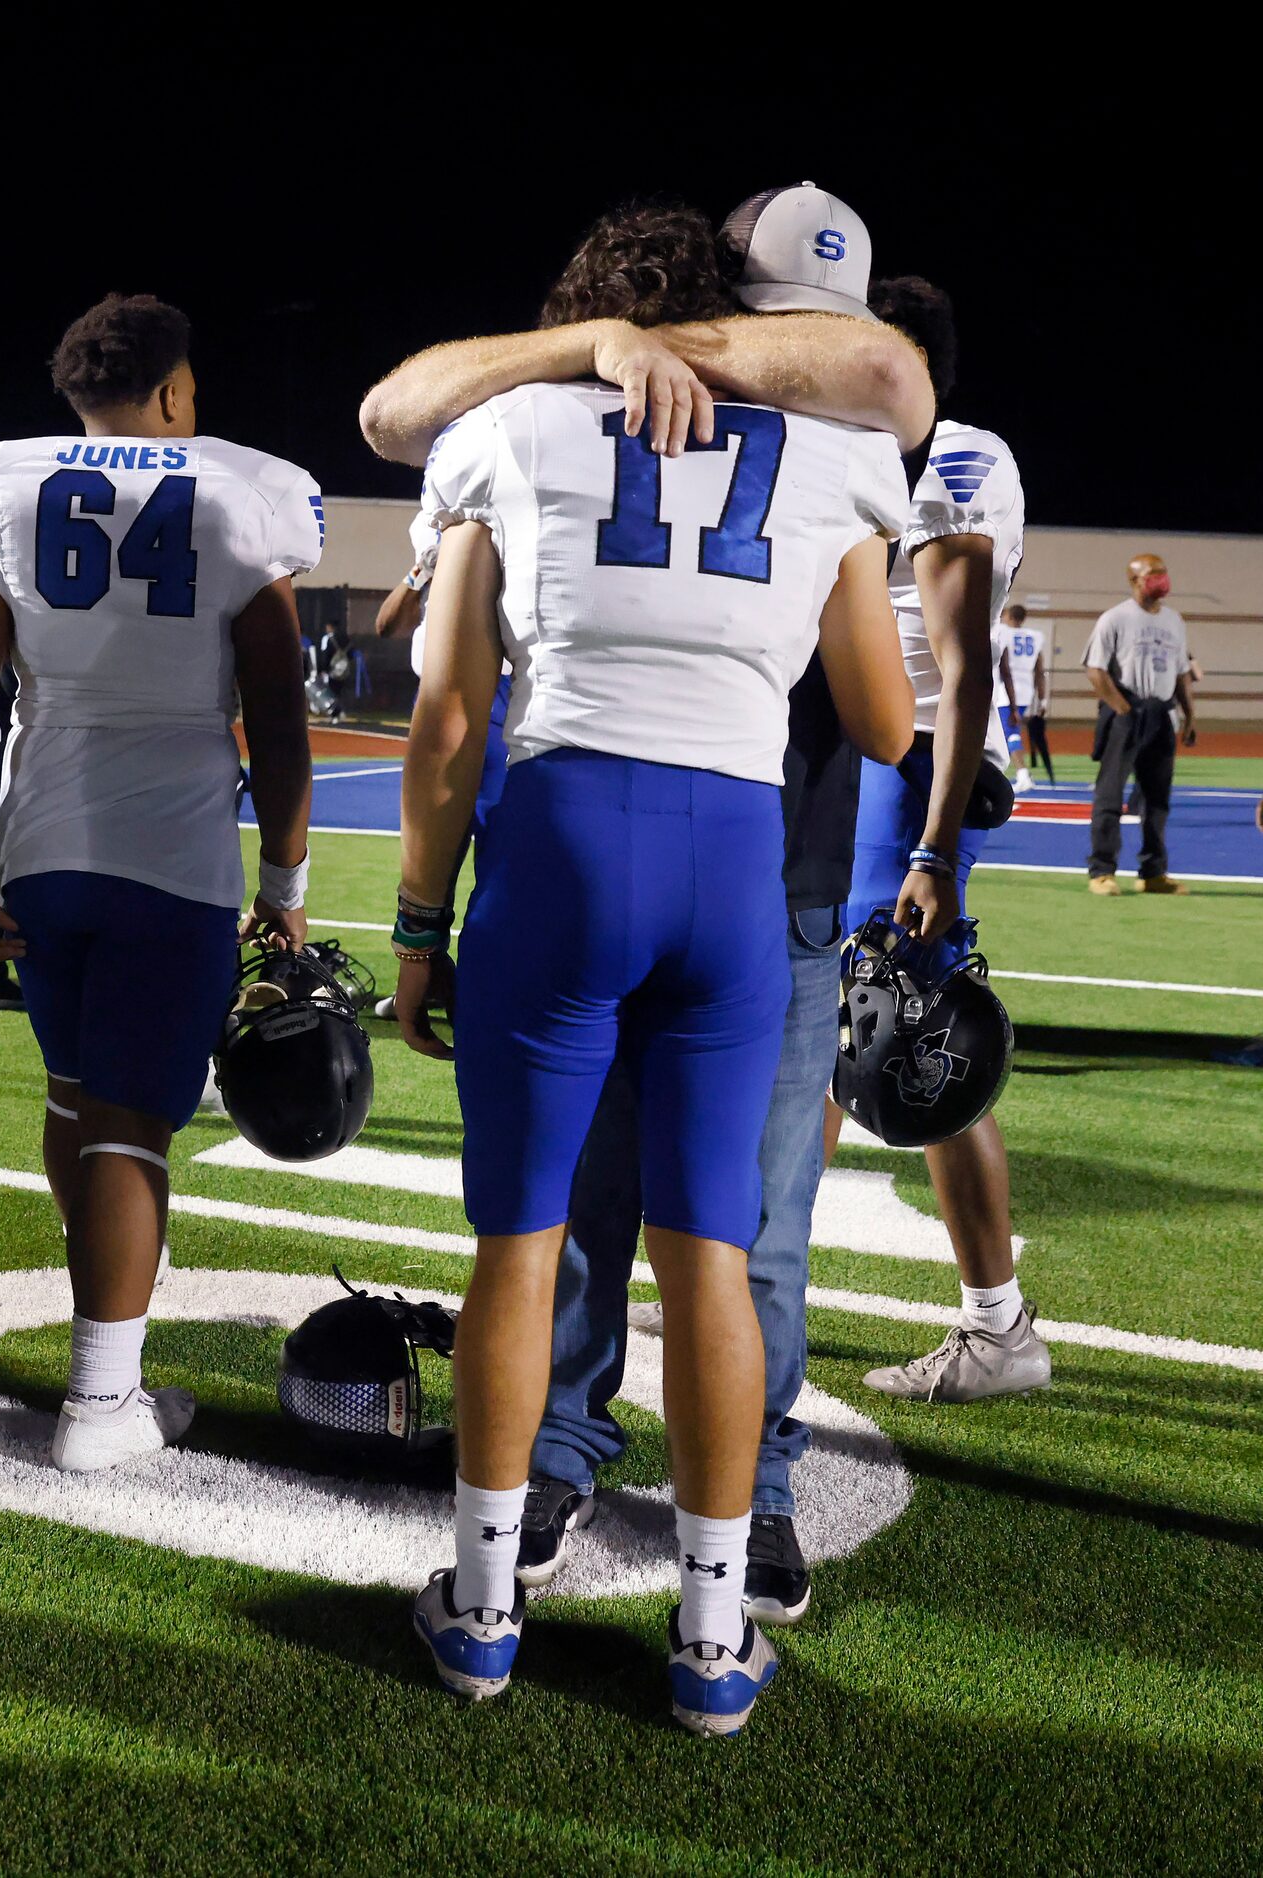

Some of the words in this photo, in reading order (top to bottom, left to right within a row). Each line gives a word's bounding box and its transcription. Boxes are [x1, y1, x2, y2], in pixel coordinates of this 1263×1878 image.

[815, 229, 847, 262] S
[56, 444, 188, 470] JONES
[595, 404, 788, 585] 17
[35, 468, 198, 618] 64
[70, 1388, 119, 1402] VAPOR
